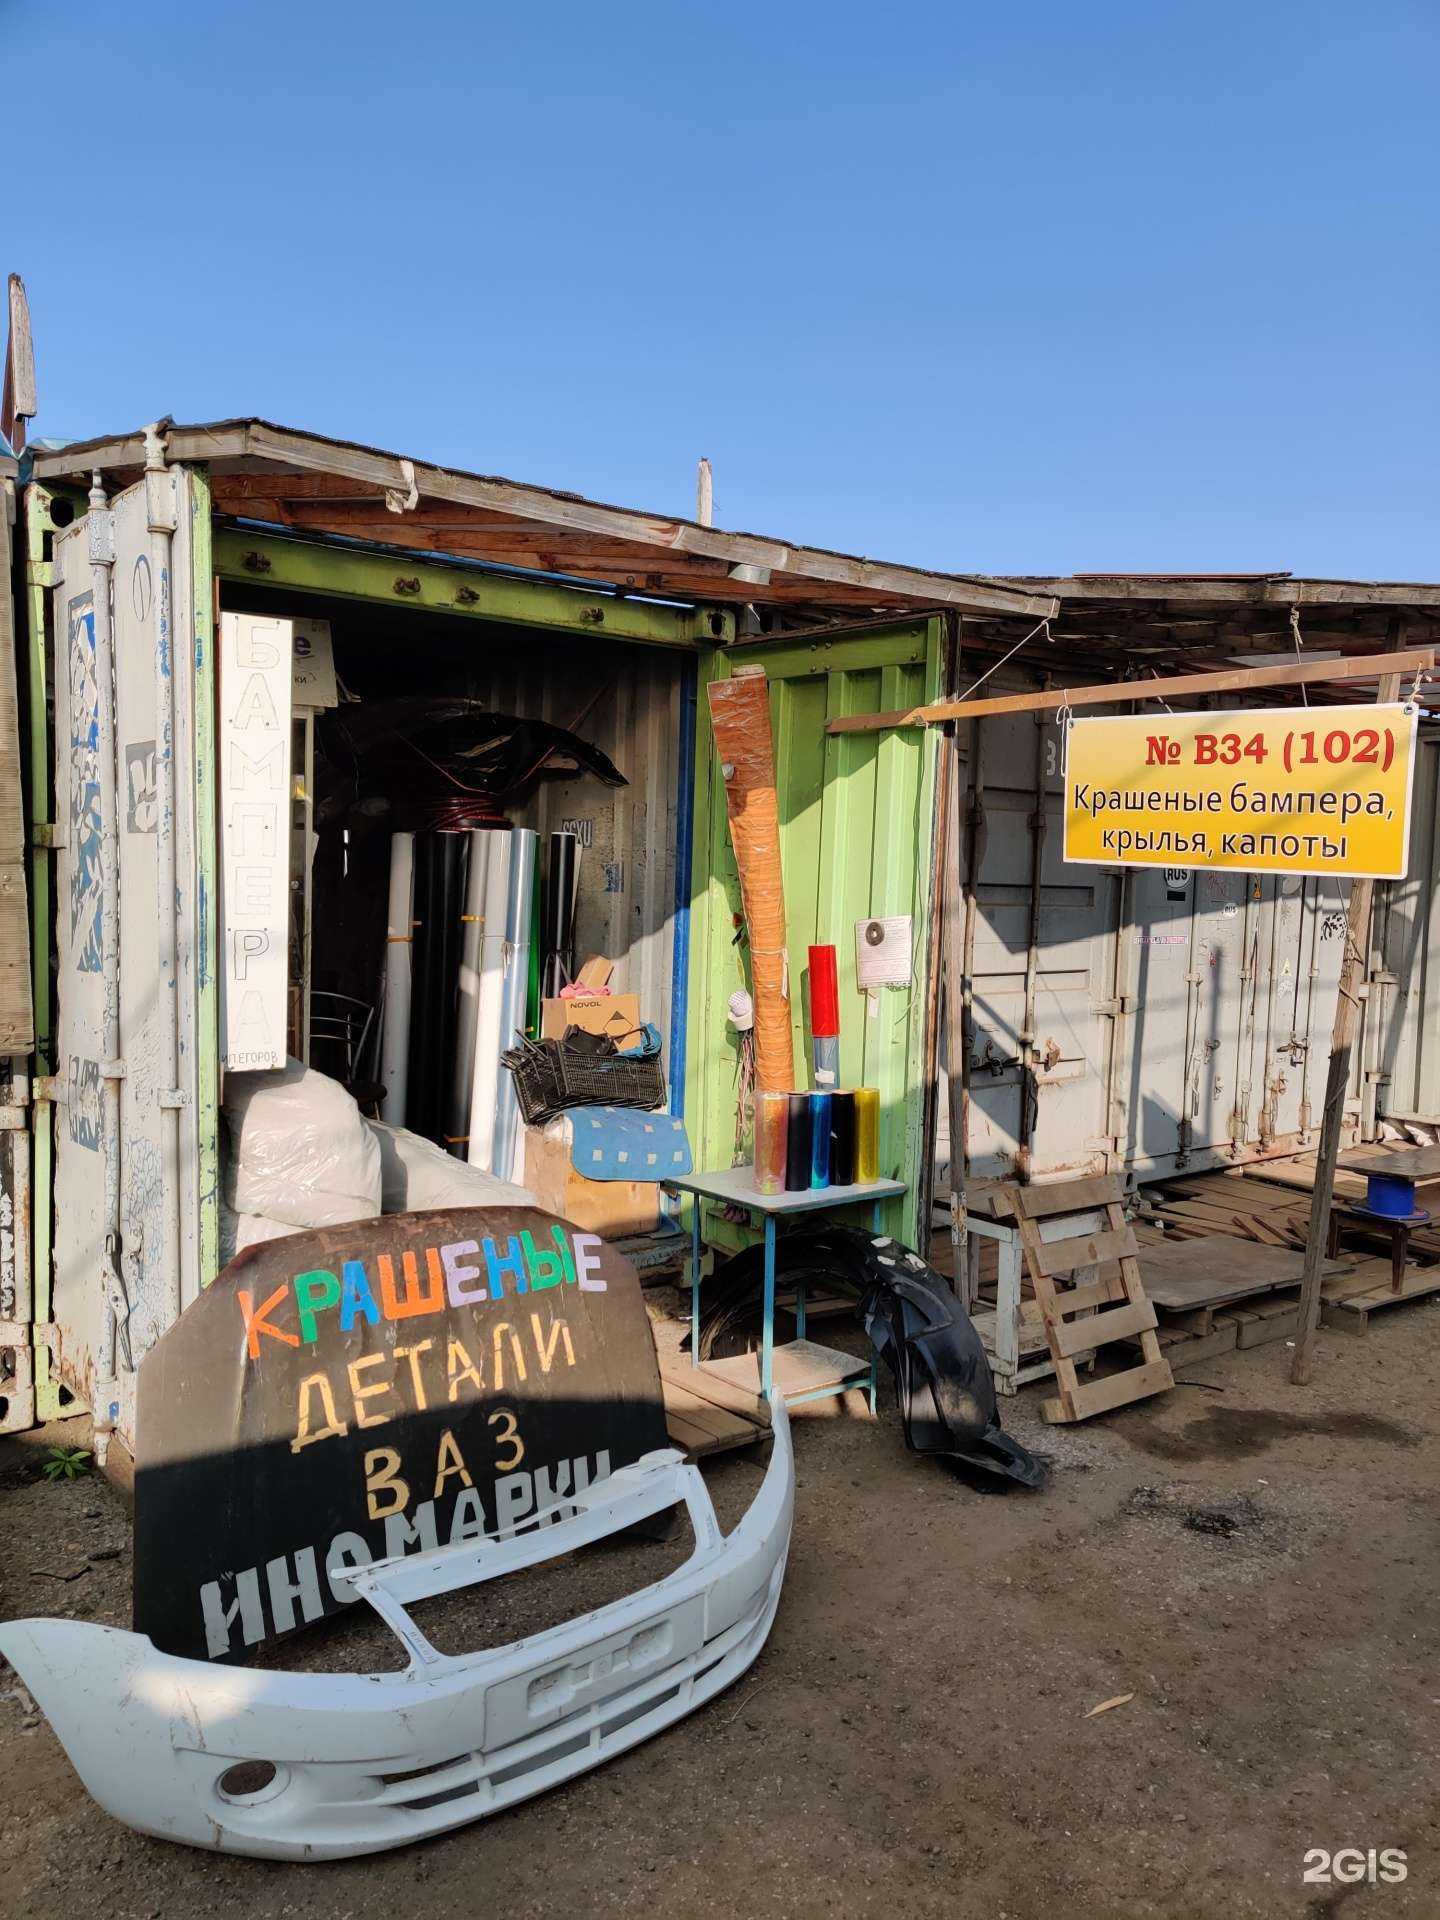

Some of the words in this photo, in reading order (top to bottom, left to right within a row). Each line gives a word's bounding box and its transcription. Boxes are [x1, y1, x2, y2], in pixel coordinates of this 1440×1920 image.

[1145, 735, 1181, 766] №
[1193, 732, 1268, 765] В34
[1283, 728, 1395, 773] (102)
[1074, 784, 1222, 818] Крашеные
[1230, 783, 1393, 824] бампера,
[229, 616, 286, 1045] БАМПЕРА
[1102, 828, 1213, 858] крылья,
[1221, 832, 1347, 858] капоты
[1167, 868, 1188, 881] RUS
[570, 1001, 601, 1009] NOVOL
[239, 1051, 278, 1065] ЕГОРОВ
[238, 1225, 607, 1359] КРАШЕНЫЕ
[291, 1314, 575, 1453] ДЕТАЛИ
